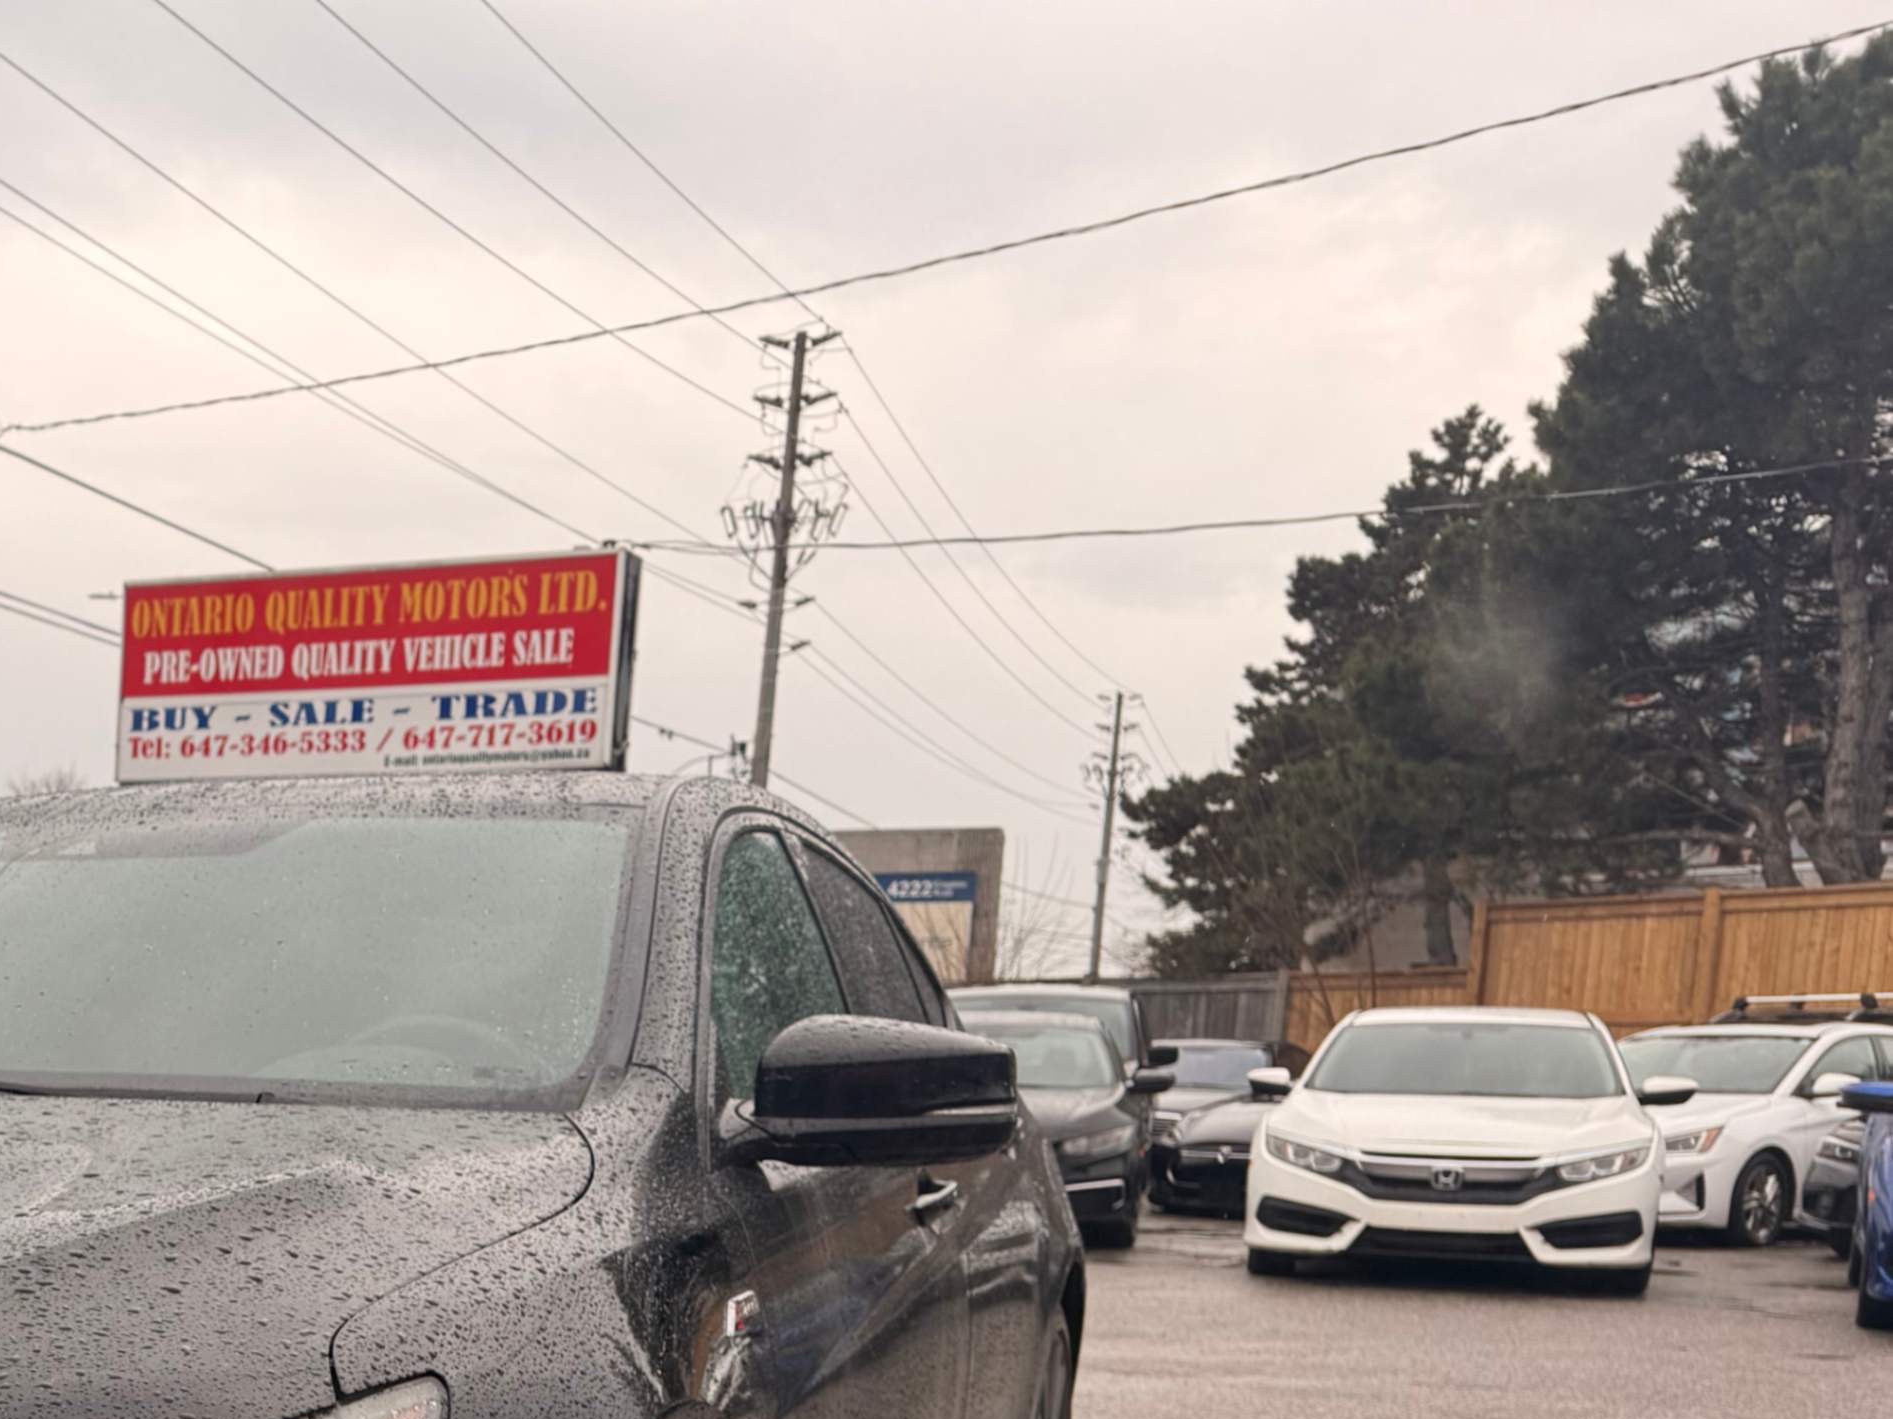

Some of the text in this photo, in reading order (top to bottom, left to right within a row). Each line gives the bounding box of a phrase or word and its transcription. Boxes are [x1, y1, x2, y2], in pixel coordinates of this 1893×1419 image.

[132, 569, 607, 638] ONTARIO QUALITY MOTORS LTD.
[143, 627, 574, 684] PRE-OWNED QUALITY VEHICLE SALE
[129, 705, 218, 732] BUY
[269, 699, 374, 727] SALE
[431, 688, 598, 720] TRADE
[128, 736, 171, 759] Tel:
[180, 729, 367, 758] 647-346-5333
[402, 718, 598, 750] 647-717-3619
